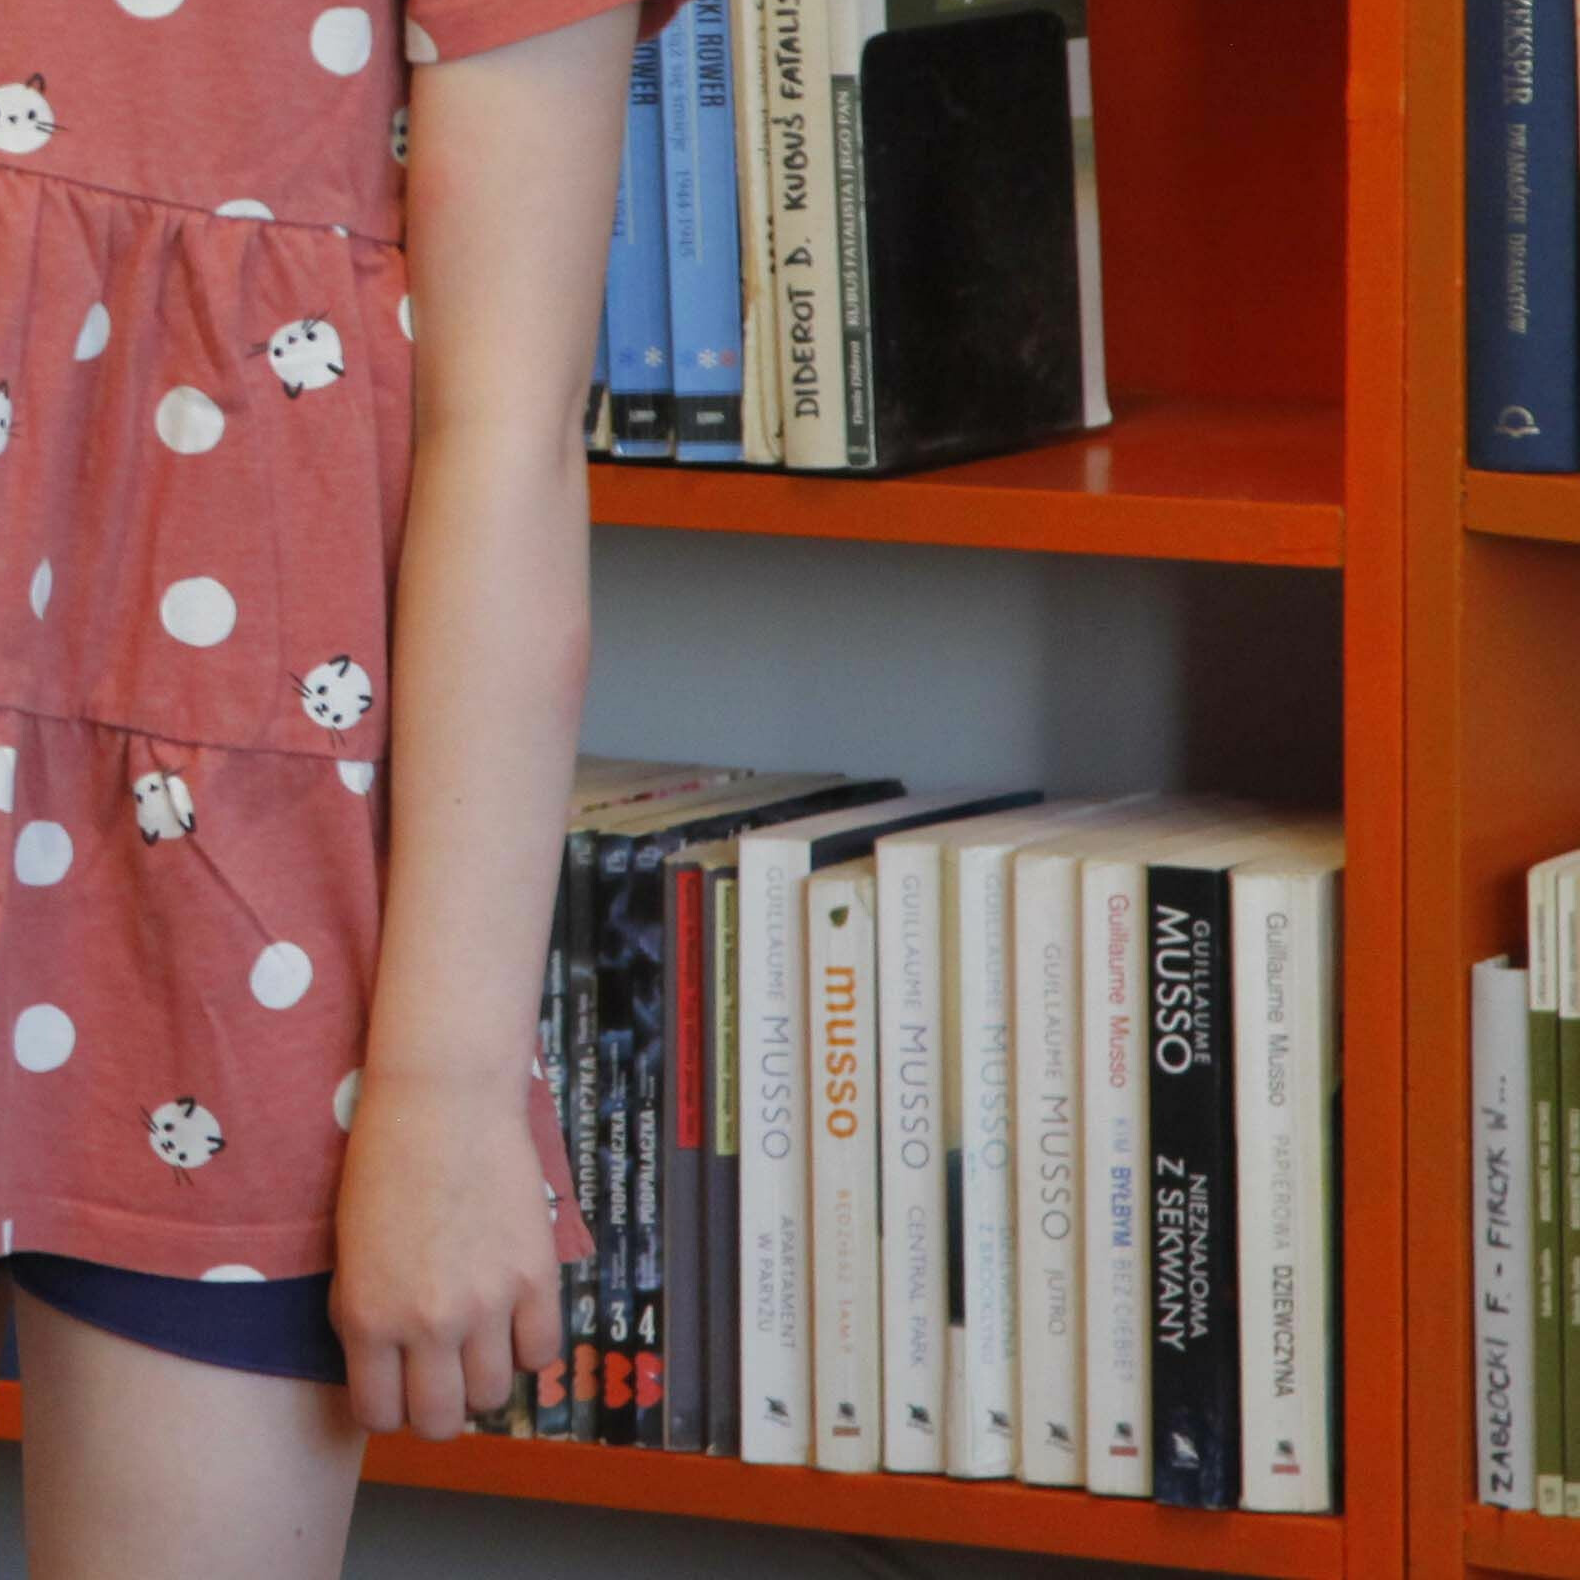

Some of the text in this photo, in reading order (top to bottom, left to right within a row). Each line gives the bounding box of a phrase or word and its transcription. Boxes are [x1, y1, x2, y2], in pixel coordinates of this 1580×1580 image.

[697, 34, 725, 109] ROWER
[837, 91, 850, 126] PAN
[774, 110, 808, 211] KUBUŚ
[785, 239, 812, 268] D.
[786, 285, 819, 419] DIDEROT
[761, 866, 791, 1160] GUILLAUME MUSSO
[825, 966, 859, 1139] musso
[900, 874, 930, 1170] GUILLAUME MUSSO
[1107, 894, 1130, 1089] Guillaume Musso
[1155, 905, 1192, 1075] MUSSO
[1193, 920, 1212, 1065] GUILLAUME
[1266, 912, 1290, 1107] Guillaume Musso
[578, 1056, 598, 1211] PODPALACZKA
[980, 1025, 1009, 1172] MUSSO
[1040, 943, 1070, 1241] GUILLAUME MUSSO
[610, 1110, 627, 1225] PODPALACZKA
[637, 1109, 655, 1224] PODPALACZKA
[1111, 1166, 1132, 1248] BYŁBYM
[577, 1296, 598, 1336] 2
[610, 1302, 628, 1342] 3
[779, 1215, 796, 1350] APARTAMENT
[906, 1205, 923, 1301] CENTRAL
[1044, 1268, 1067, 1337] JUTRO
[1157, 1156, 1186, 1352] Z SEKWANY
[1188, 1174, 1210, 1339] NIEZNAJOMA
[1272, 1135, 1294, 1398] PAPIEROWA DZIEWCZYNA
[1484, 1147, 1514, 1494] ZABŁOCKI FIRCYK
[637, 1305, 656, 1344] 4
